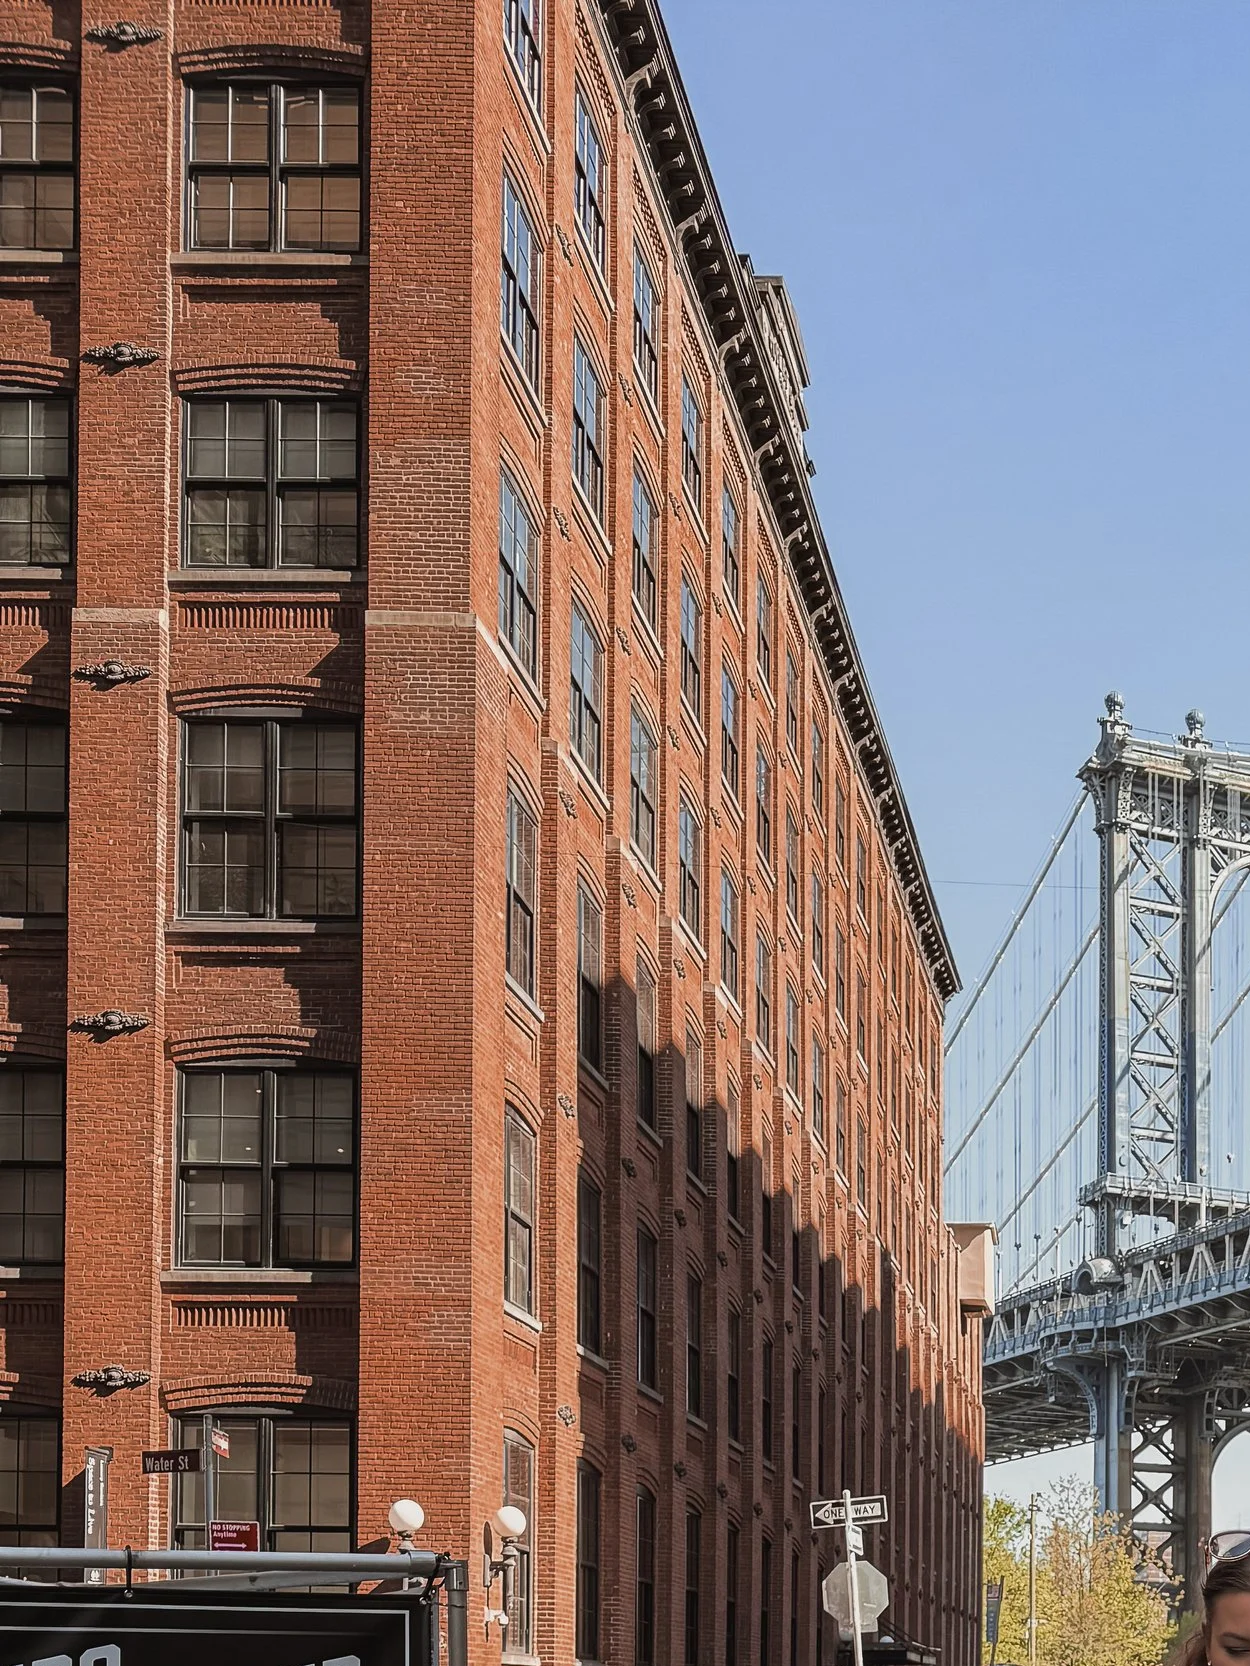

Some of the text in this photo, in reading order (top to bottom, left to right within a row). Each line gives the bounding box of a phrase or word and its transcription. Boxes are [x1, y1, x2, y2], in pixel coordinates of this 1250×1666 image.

[145, 1456, 189, 1472] Water St
[824, 1505, 876, 1518] ONE WAY
[213, 1531, 237, 1539] Anytime
